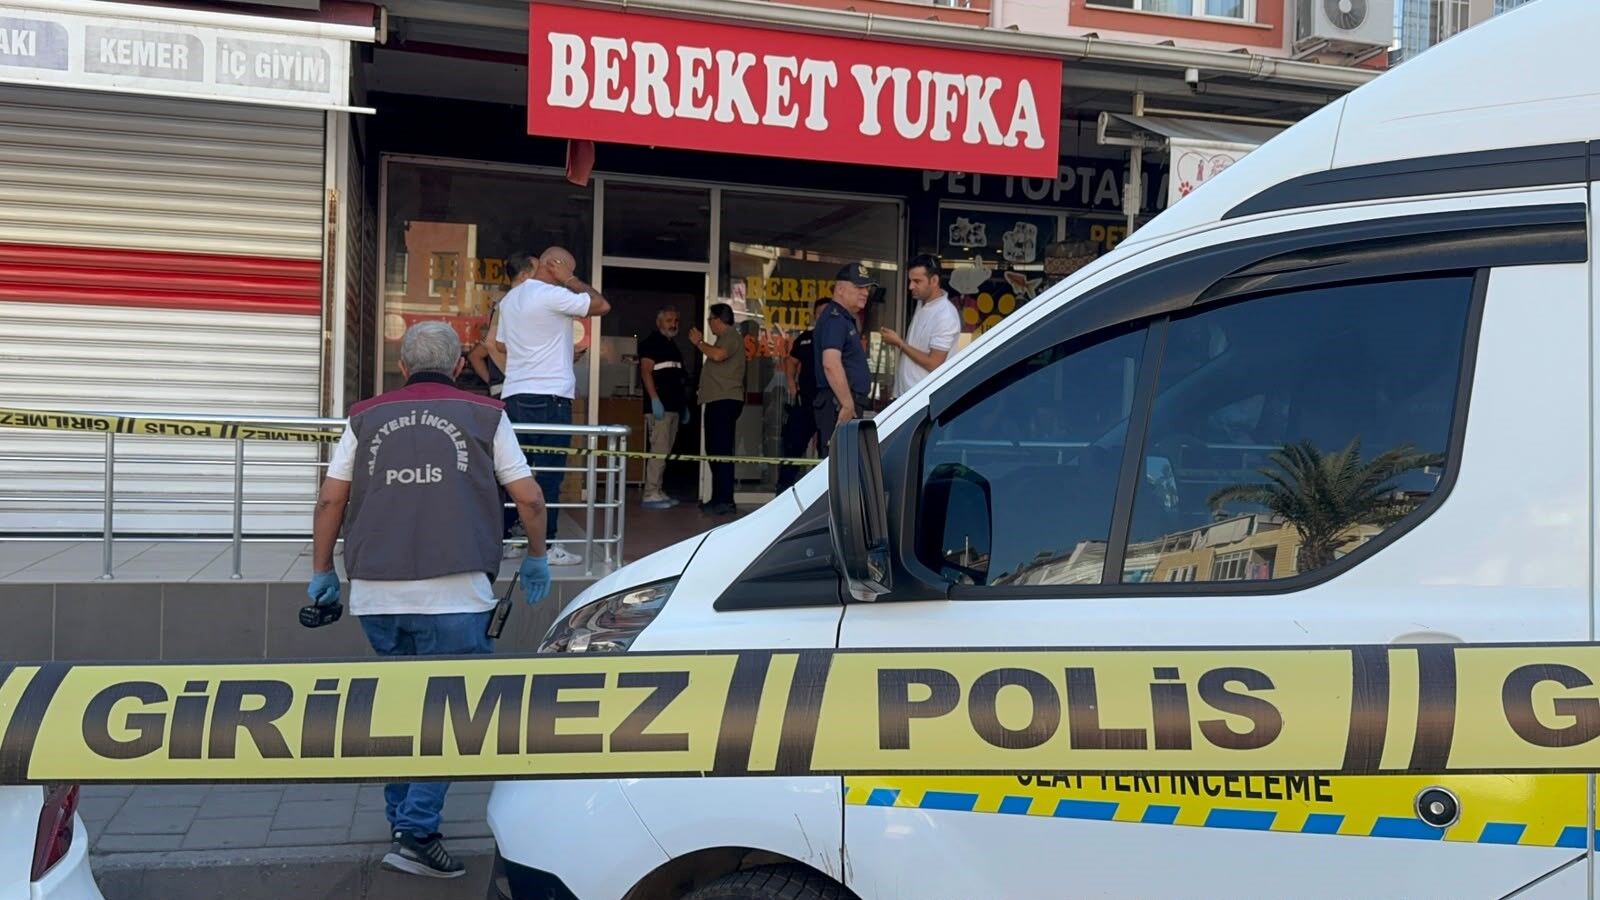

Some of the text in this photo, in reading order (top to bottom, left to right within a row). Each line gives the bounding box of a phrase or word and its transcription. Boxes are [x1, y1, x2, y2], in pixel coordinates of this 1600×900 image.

[100, 37, 188, 70] KEMER
[222, 43, 325, 83] İÇ GİYİM
[547, 32, 1045, 149] BEREKET YUFKA
[746, 276, 836, 302] BEREK
[763, 304, 815, 332] YUF
[379, 410, 416, 436] YERİ
[421, 410, 468, 472] İNCELEME
[386, 464, 442, 485] POLİS
[81, 670, 692, 761] GİRİLMEZ
[877, 666, 1285, 752] POLİS
